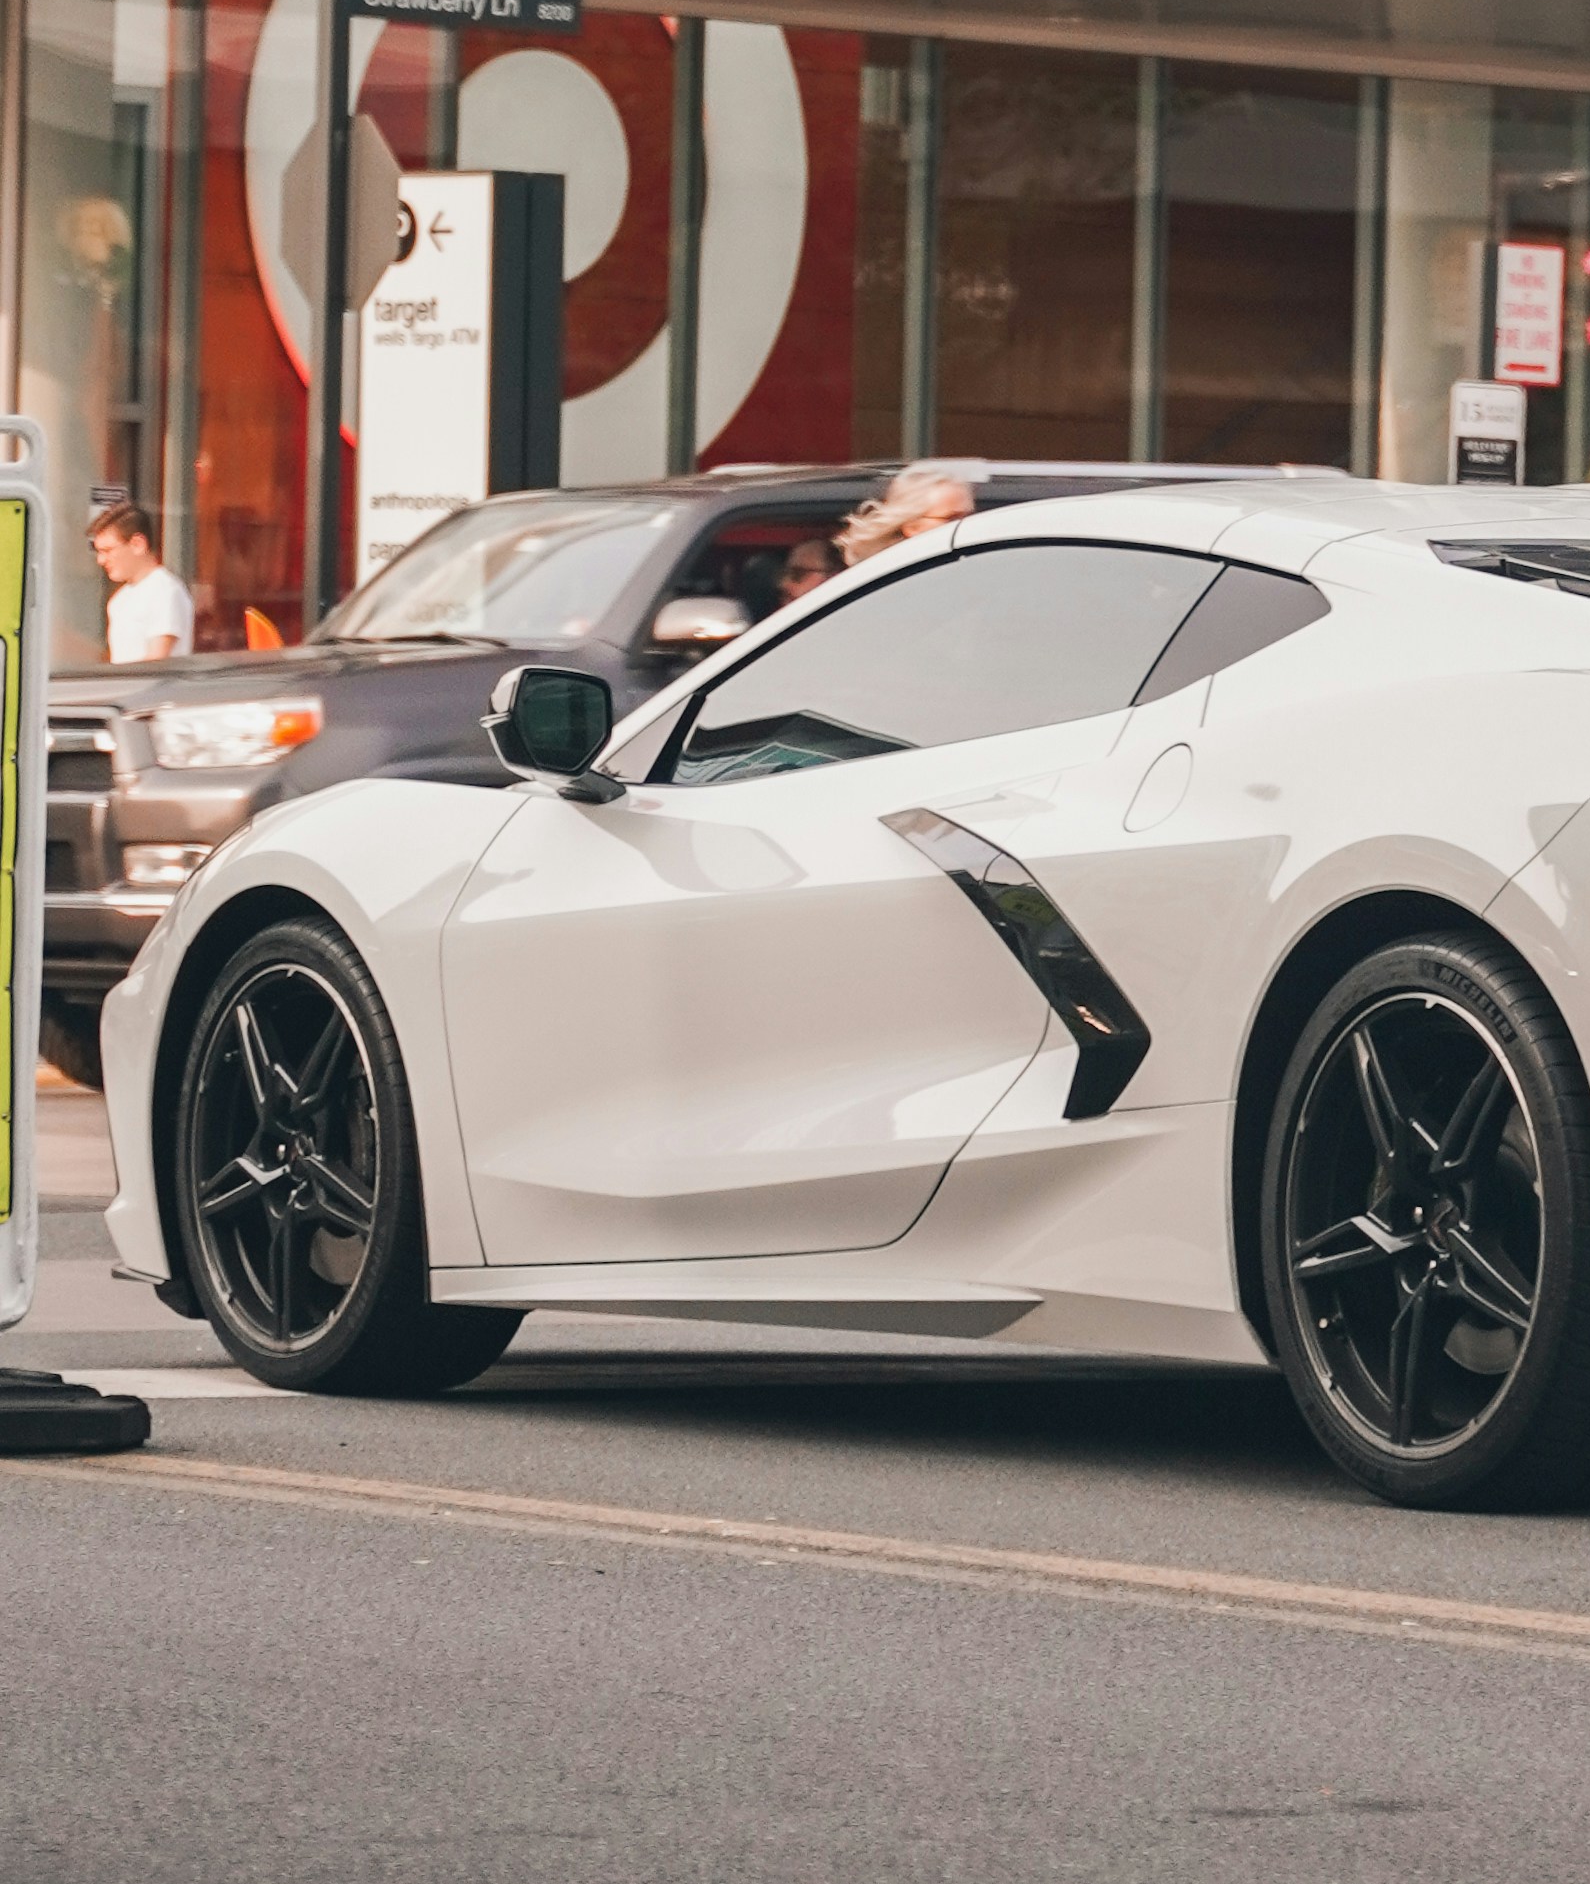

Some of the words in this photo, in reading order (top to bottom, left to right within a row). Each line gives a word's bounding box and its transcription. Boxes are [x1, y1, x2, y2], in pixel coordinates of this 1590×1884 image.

[374, 296, 438, 328] target
[449, 327, 480, 345] ATM
[1438, 966, 1515, 1041] MICHELIN
